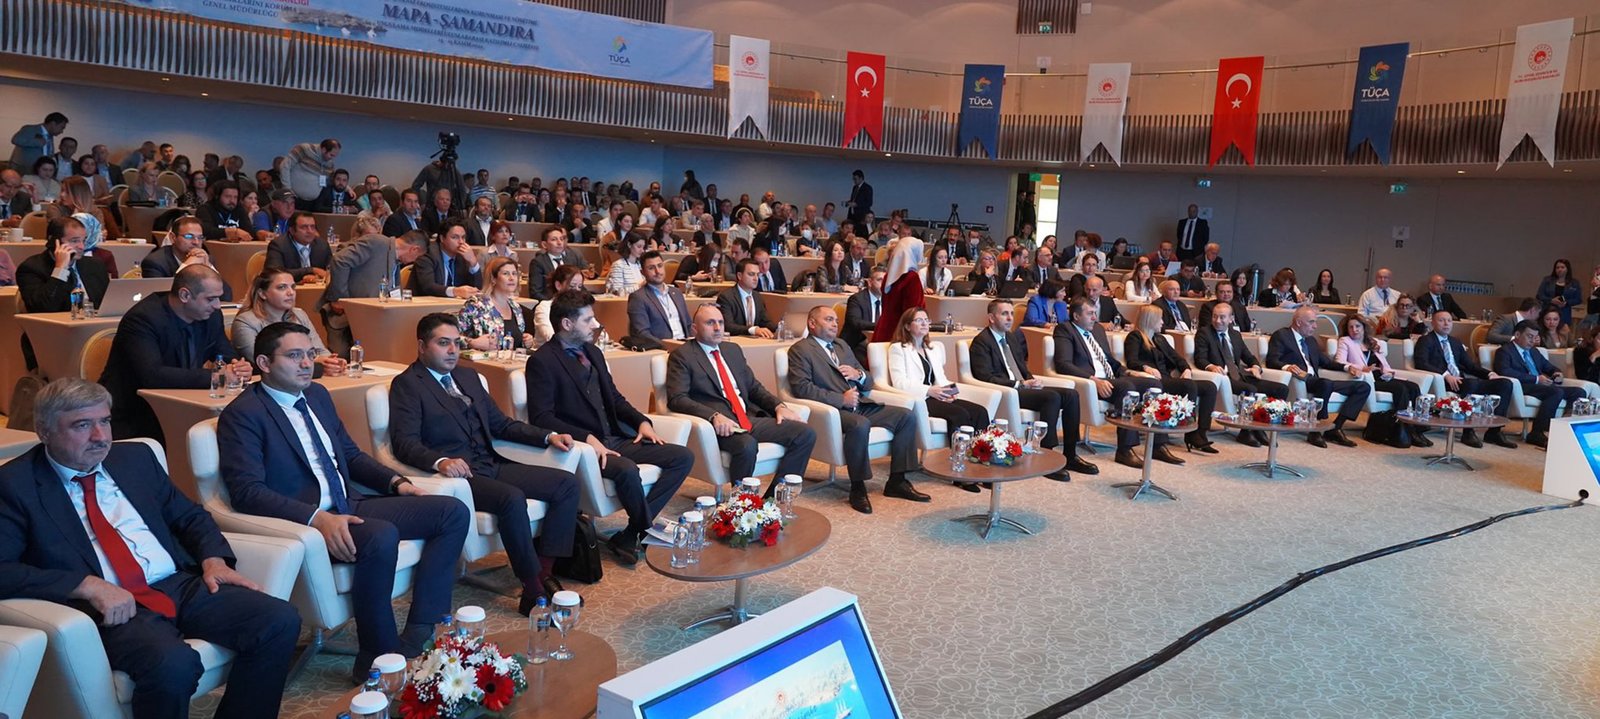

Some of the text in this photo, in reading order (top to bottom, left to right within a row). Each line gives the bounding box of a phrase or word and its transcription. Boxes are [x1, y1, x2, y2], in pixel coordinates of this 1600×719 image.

[202, 0, 227, 10] GENEL
[608, 54, 631, 64] TÜÇA
[1361, 86, 1390, 98] TÜÇA
[969, 96, 993, 106] TÜÇA
